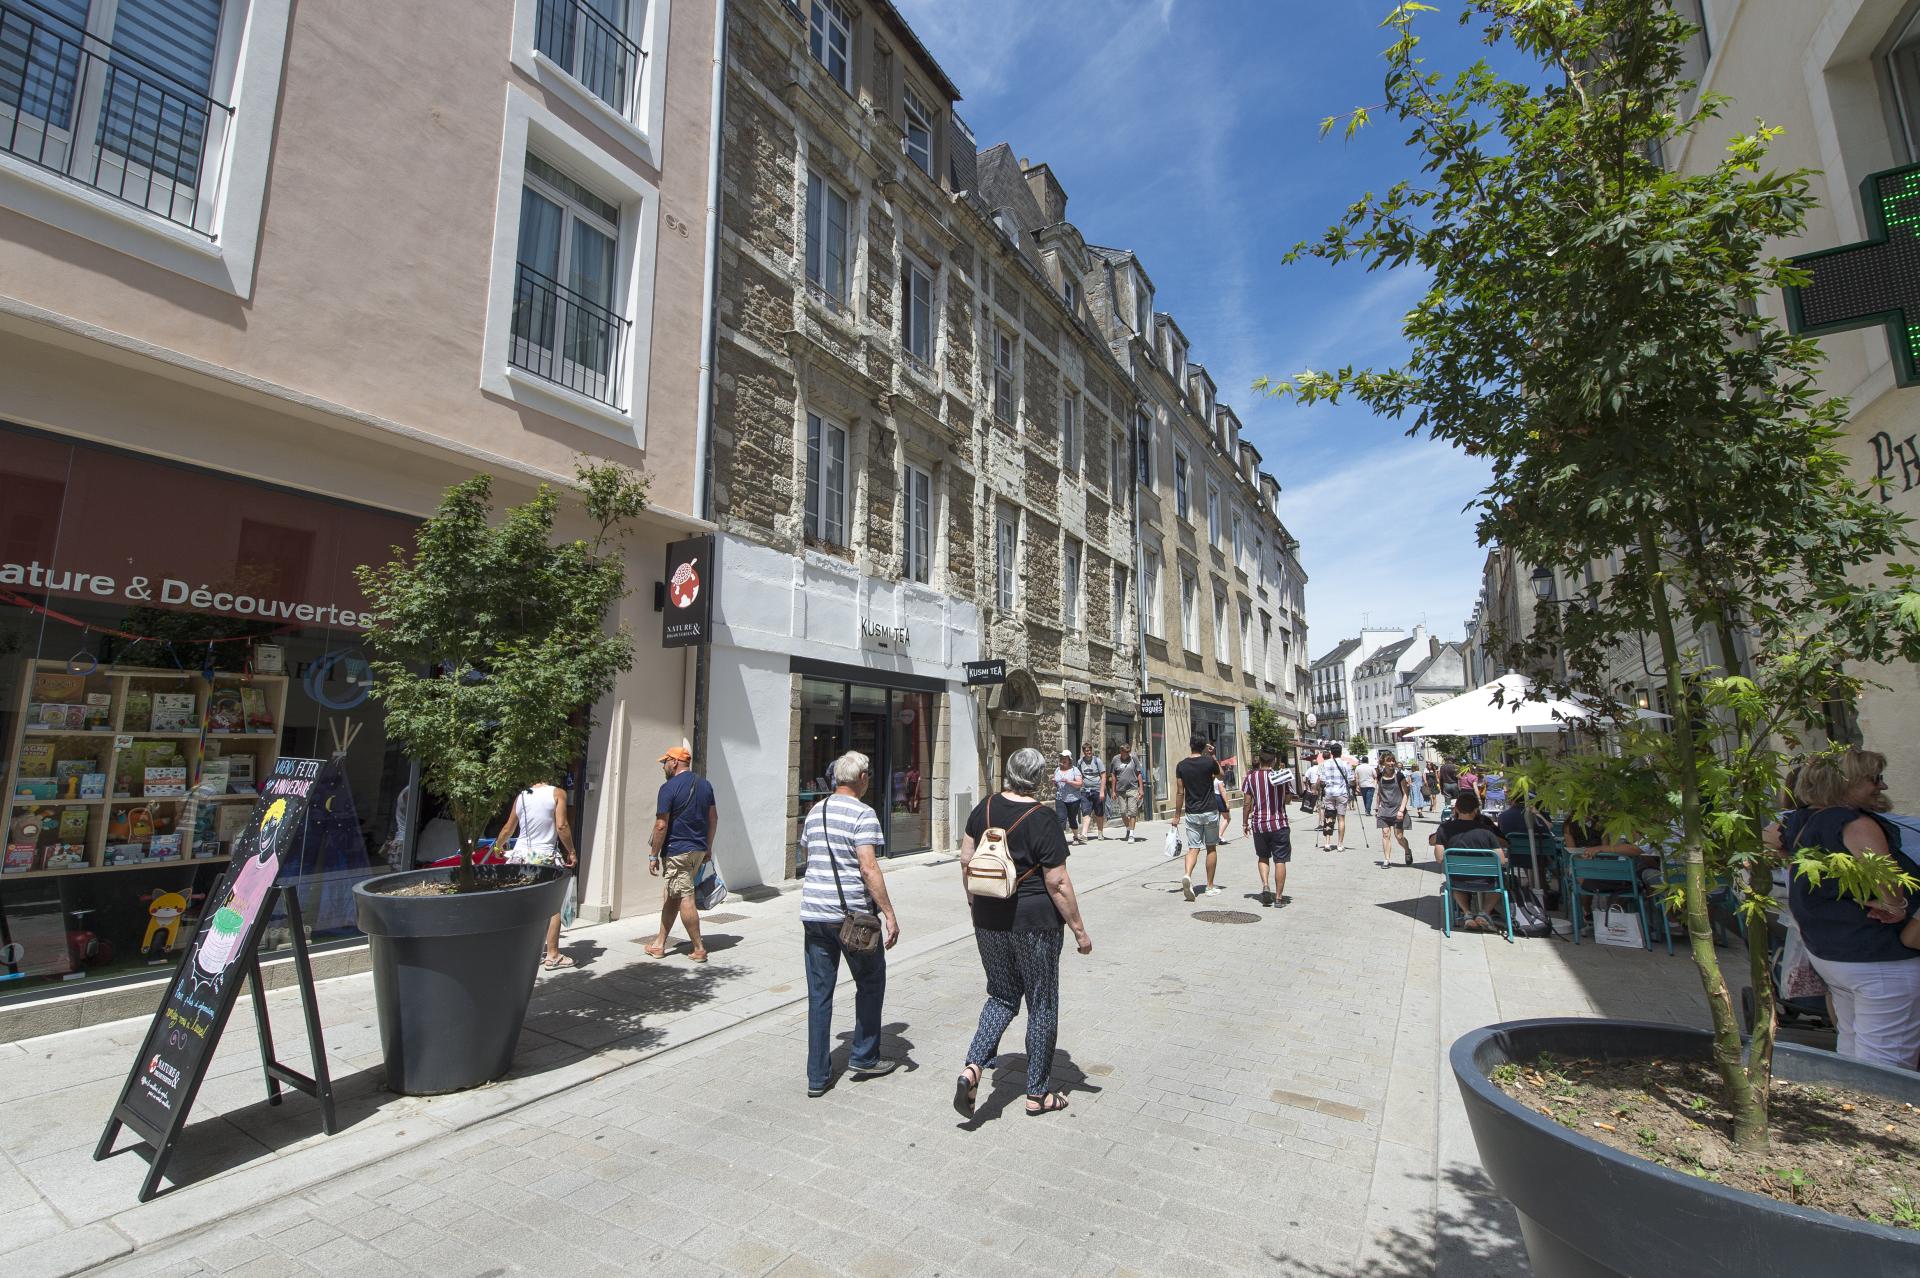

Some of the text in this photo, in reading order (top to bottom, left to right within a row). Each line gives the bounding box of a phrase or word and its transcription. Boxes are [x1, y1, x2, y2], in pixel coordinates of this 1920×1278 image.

[0, 561, 374, 629] ature & Découvertes
[861, 616, 911, 647] KUSMI TEA
[969, 665, 1003, 678] KUSMI TEA
